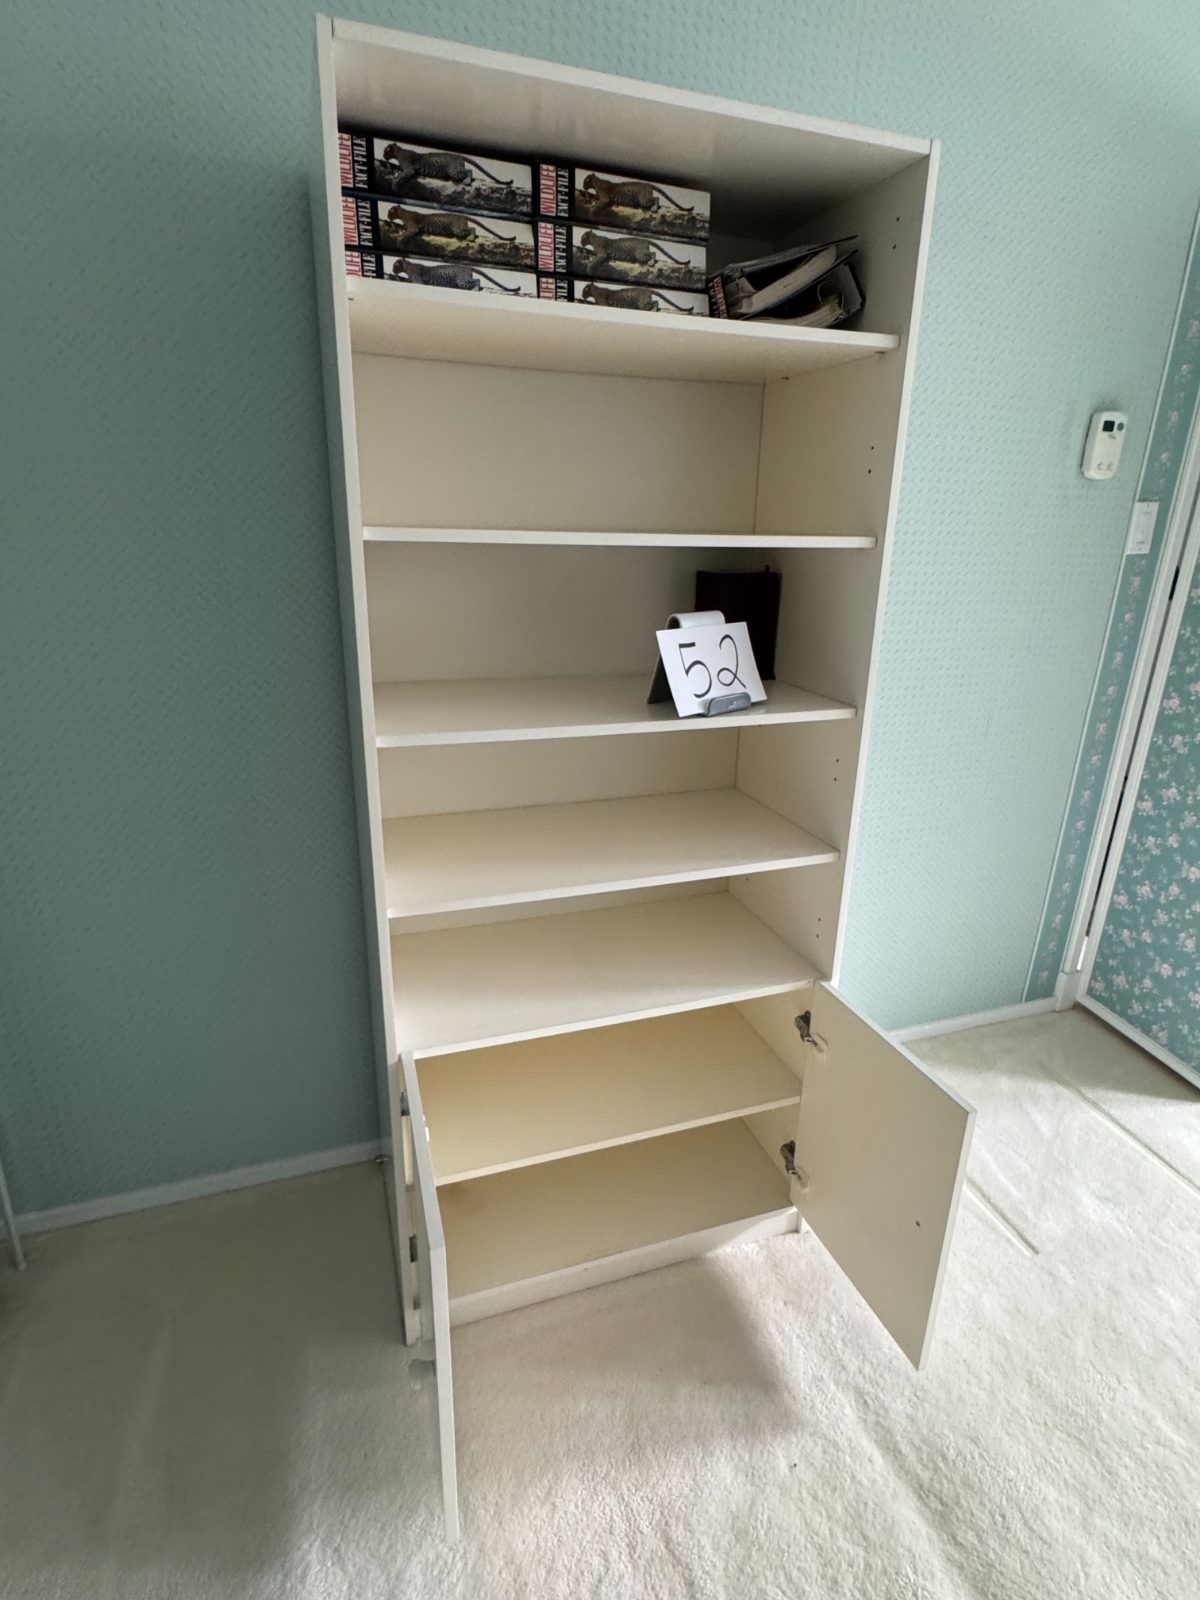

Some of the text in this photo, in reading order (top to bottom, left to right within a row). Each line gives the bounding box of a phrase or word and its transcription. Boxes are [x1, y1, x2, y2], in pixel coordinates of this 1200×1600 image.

[339, 133, 352, 187] WILDLIFE
[541, 165, 555, 215] WILDLIFE
[342, 197, 358, 244] WILDLIFE
[539, 223, 554, 271] WILDLIFE
[678, 634, 747, 699] 52
